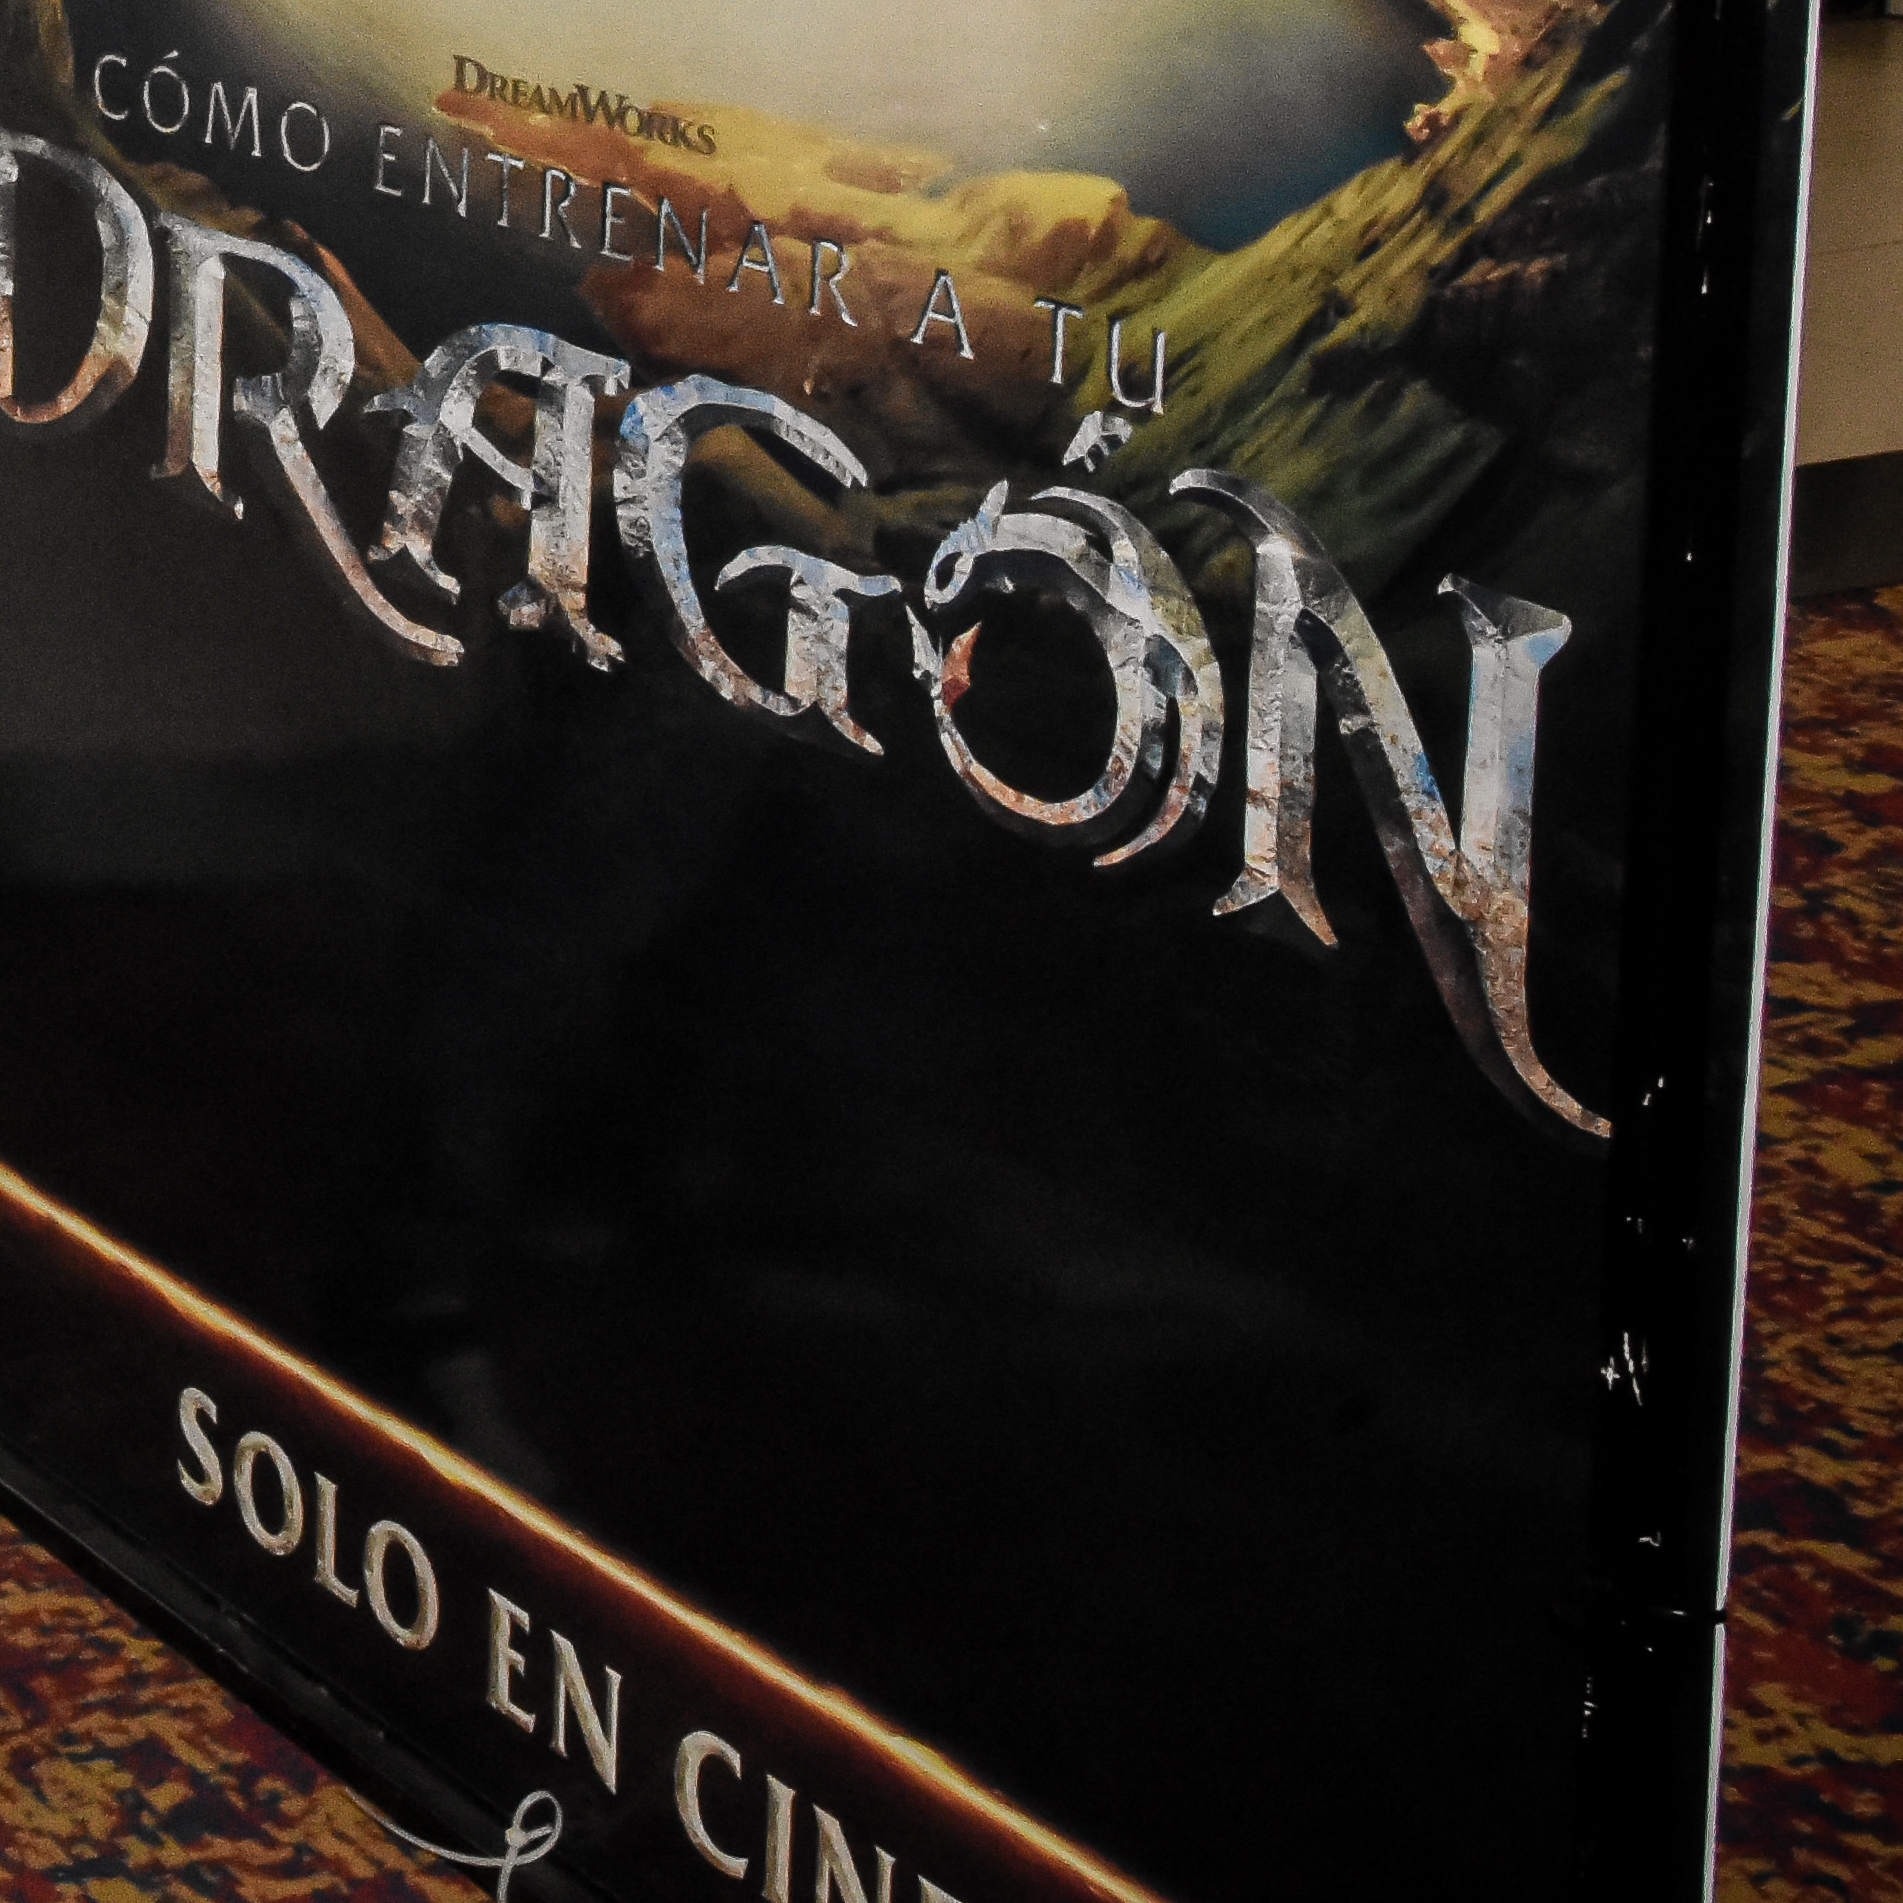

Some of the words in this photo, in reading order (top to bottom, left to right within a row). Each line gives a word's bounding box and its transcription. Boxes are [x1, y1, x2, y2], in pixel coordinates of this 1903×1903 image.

[93, 51, 332, 173] CÓMO
[372, 123, 859, 329] ENTRENAR
[909, 267, 975, 361] A
[1033, 296, 1166, 416] TU
[177, 1386, 440, 1650] SOLO
[486, 1587, 622, 1796] EN
[673, 1729, 963, 1903] CIN
